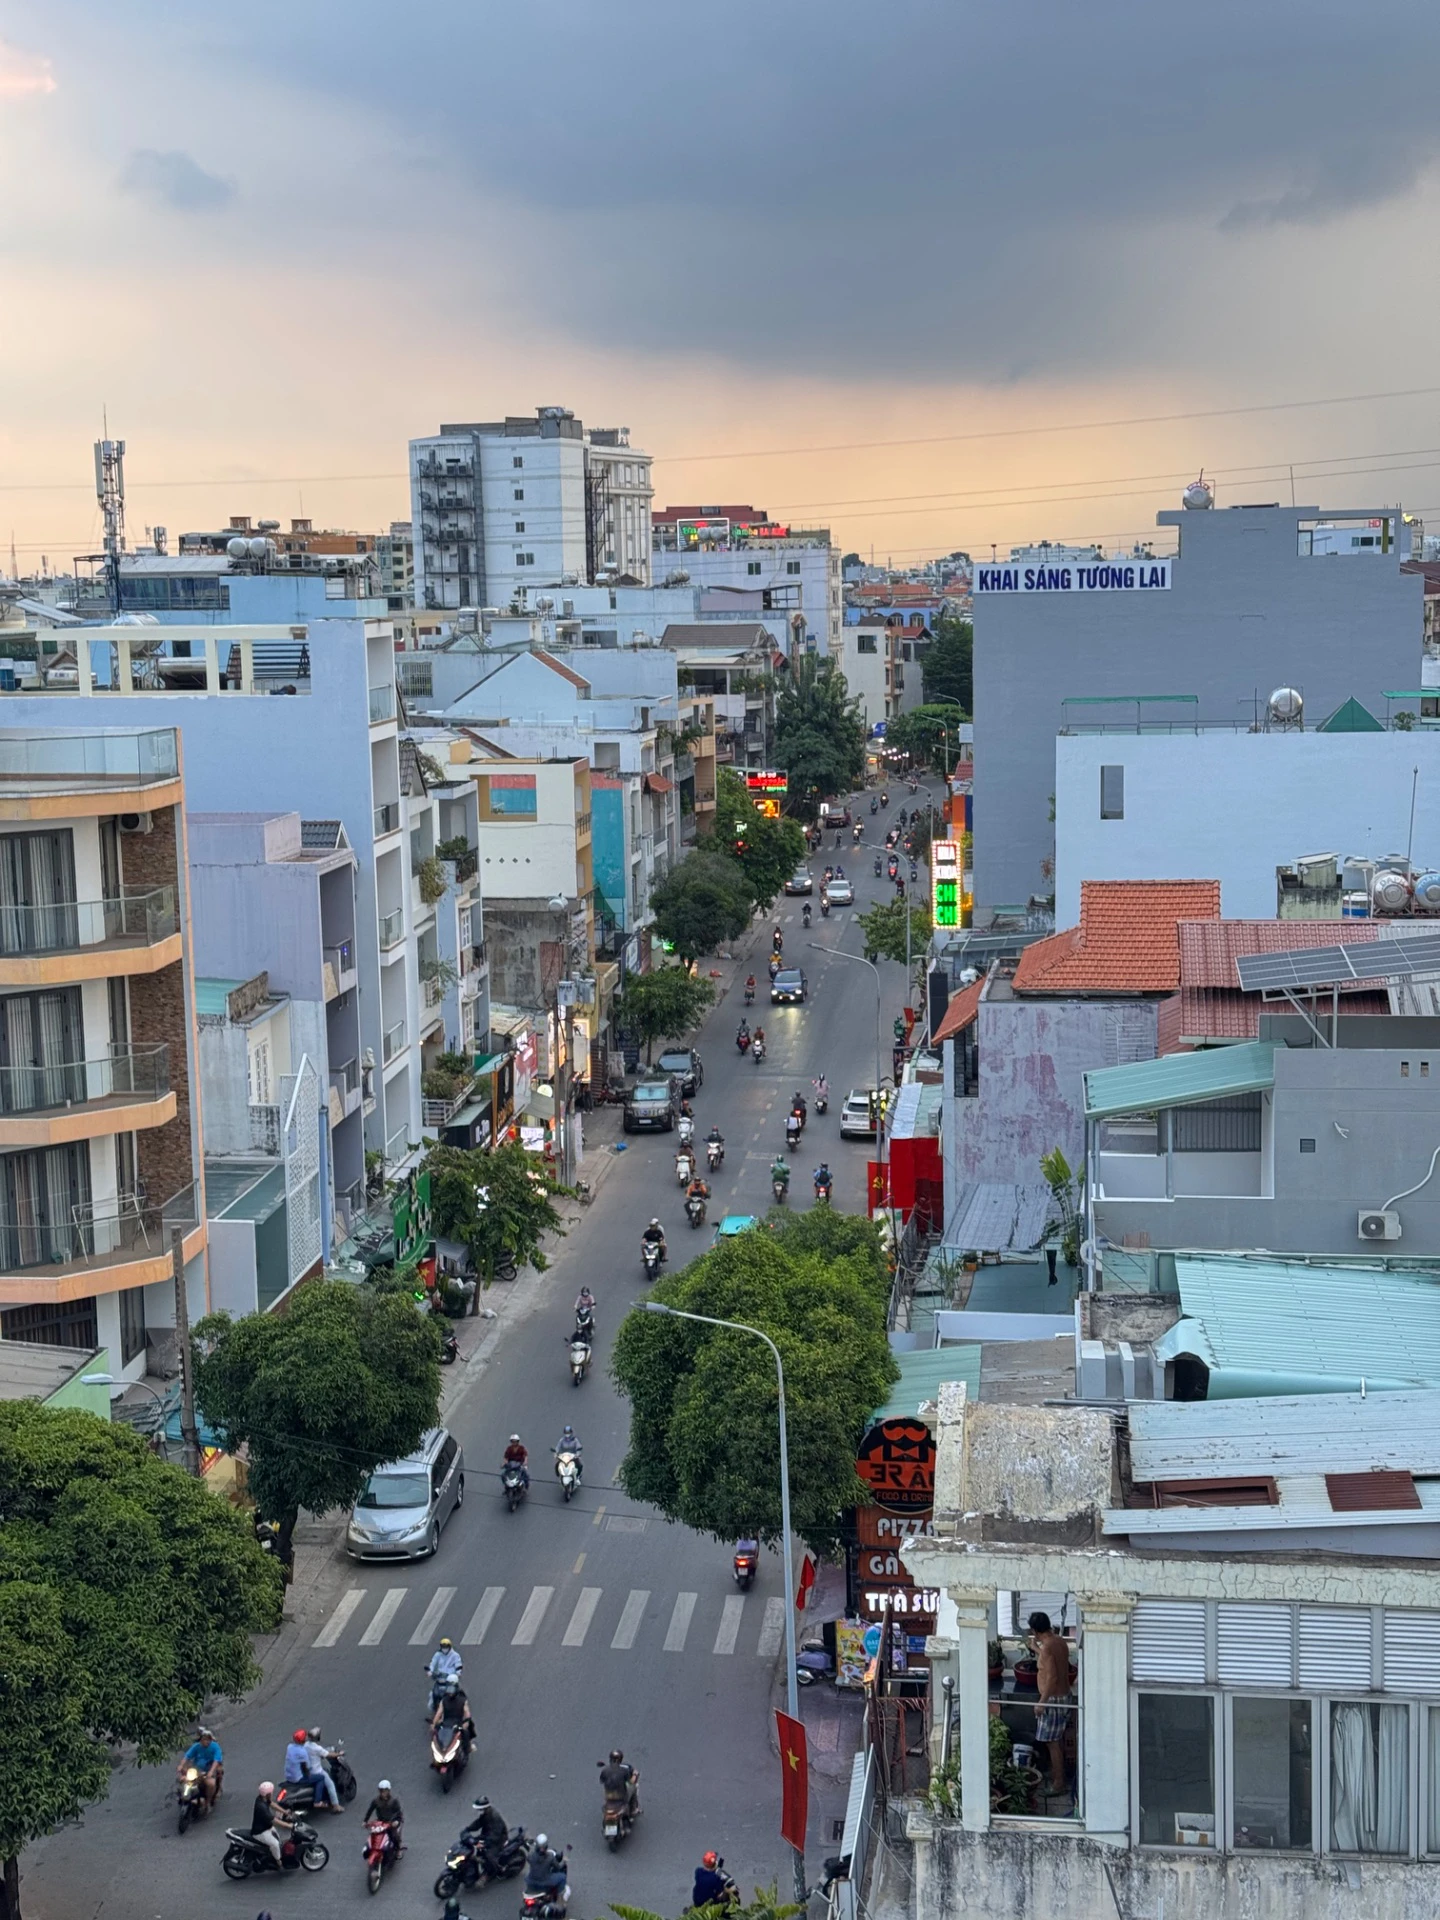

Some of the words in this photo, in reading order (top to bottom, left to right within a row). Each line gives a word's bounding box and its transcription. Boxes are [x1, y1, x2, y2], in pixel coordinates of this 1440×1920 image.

[979, 569, 1018, 591] KHAI
[1024, 565, 1071, 590] SÁNG
[1077, 566, 1134, 589] TƯƠNG
[1139, 566, 1166, 587] LAI
[936, 884, 957, 902] CHI
[936, 906, 957, 924] CHI
[876, 1491, 899, 1501] FOOD
[902, 1492, 909, 1502] &
[911, 1493, 933, 1504] DRIN
[877, 1518, 936, 1537] PIZZA
[870, 1551, 899, 1575] GÀ
[865, 1589, 908, 1613] TRÀ
